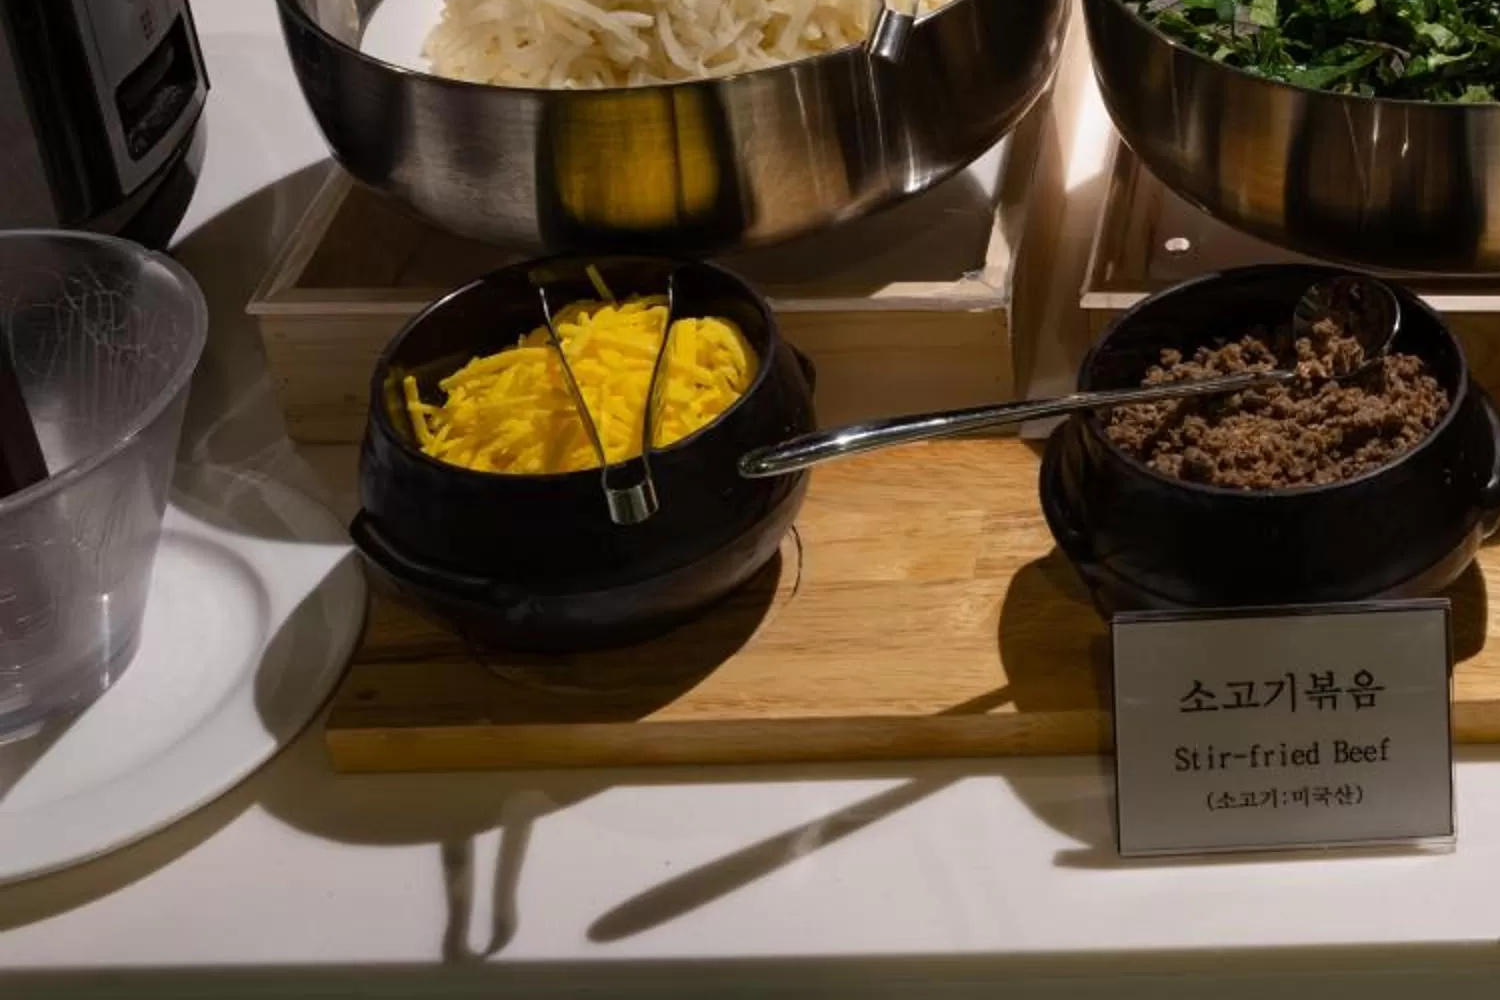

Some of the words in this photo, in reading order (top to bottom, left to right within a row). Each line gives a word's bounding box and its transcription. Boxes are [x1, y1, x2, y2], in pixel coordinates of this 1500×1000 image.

[1179, 669, 1384, 712] 소고기볶음
[1174, 740, 1320, 772] Stir-fried
[1334, 737, 1391, 764] Beef
